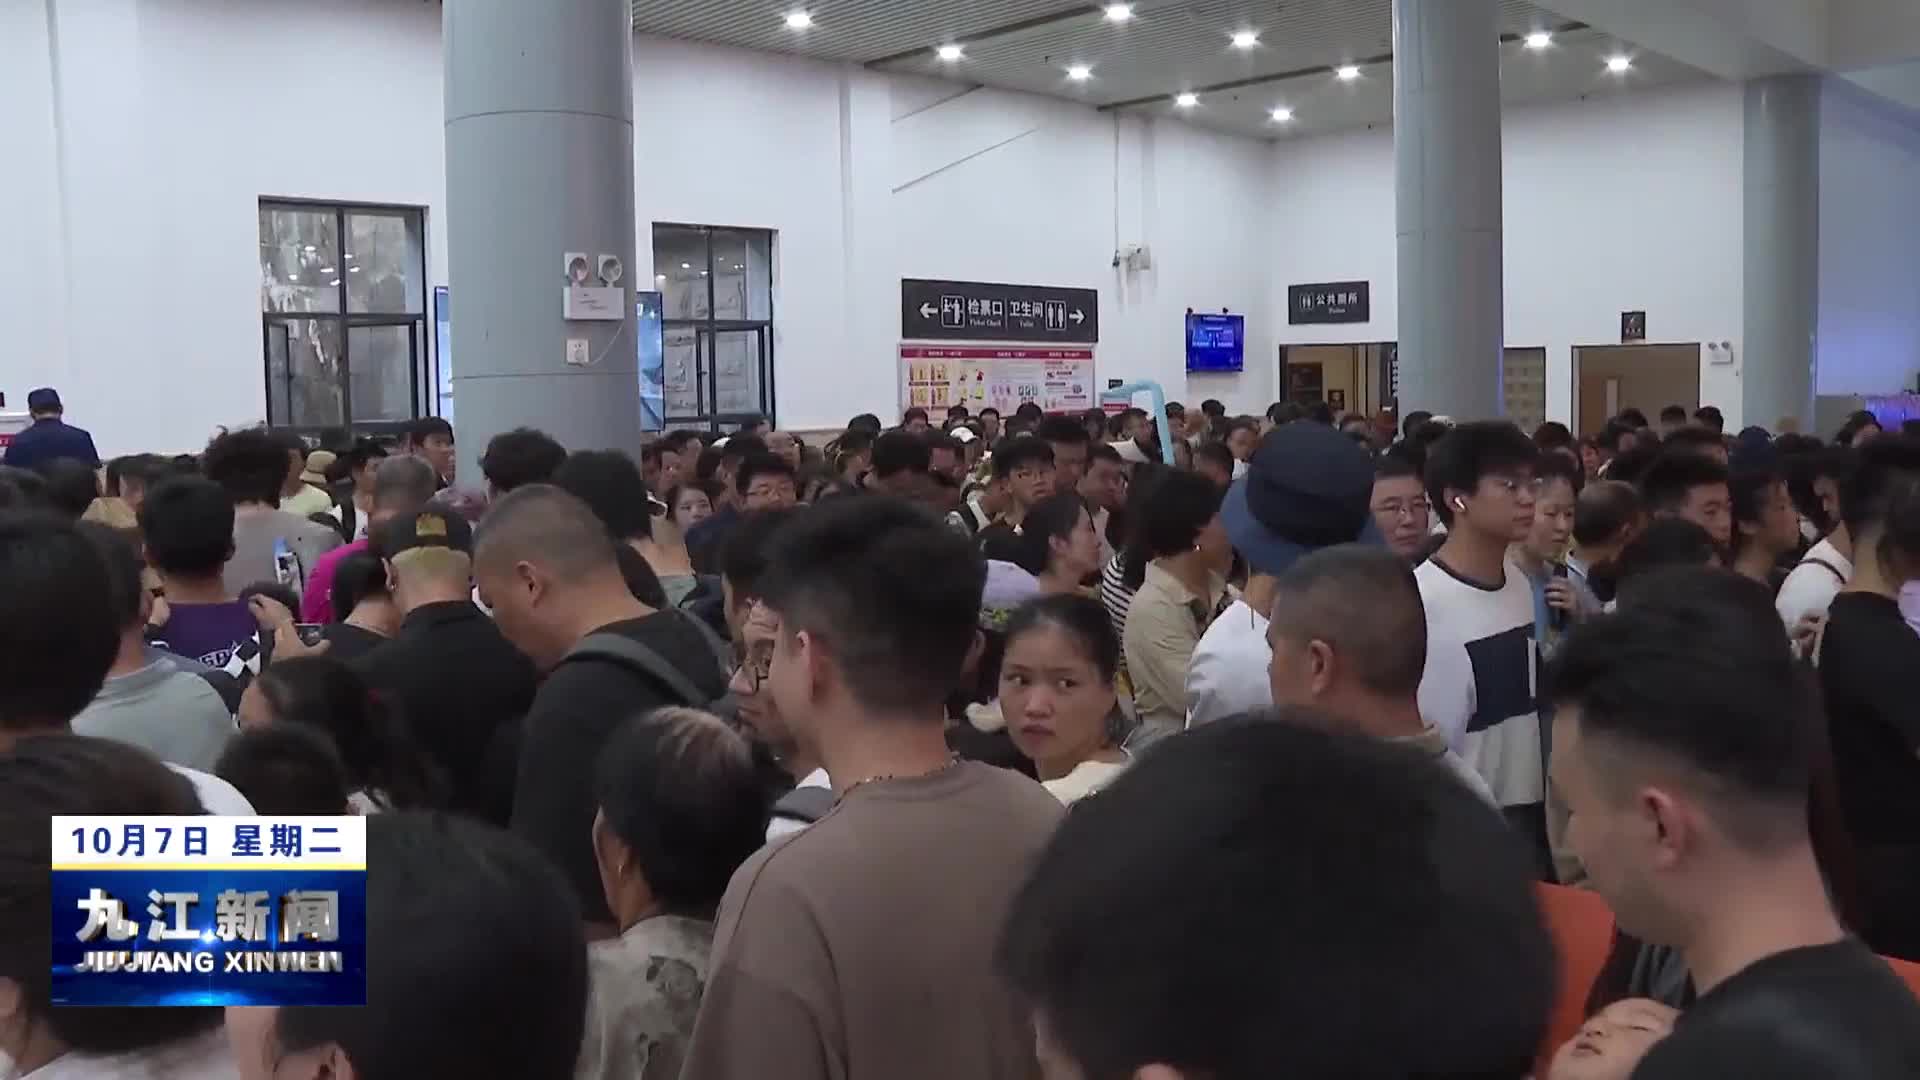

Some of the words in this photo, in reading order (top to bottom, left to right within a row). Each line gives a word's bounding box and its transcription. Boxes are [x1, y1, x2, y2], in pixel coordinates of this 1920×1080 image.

[1316, 292, 1358, 305] 公共厕所
[967, 298, 1003, 316] 检票口
[1009, 301, 1043, 318] 卫生间
